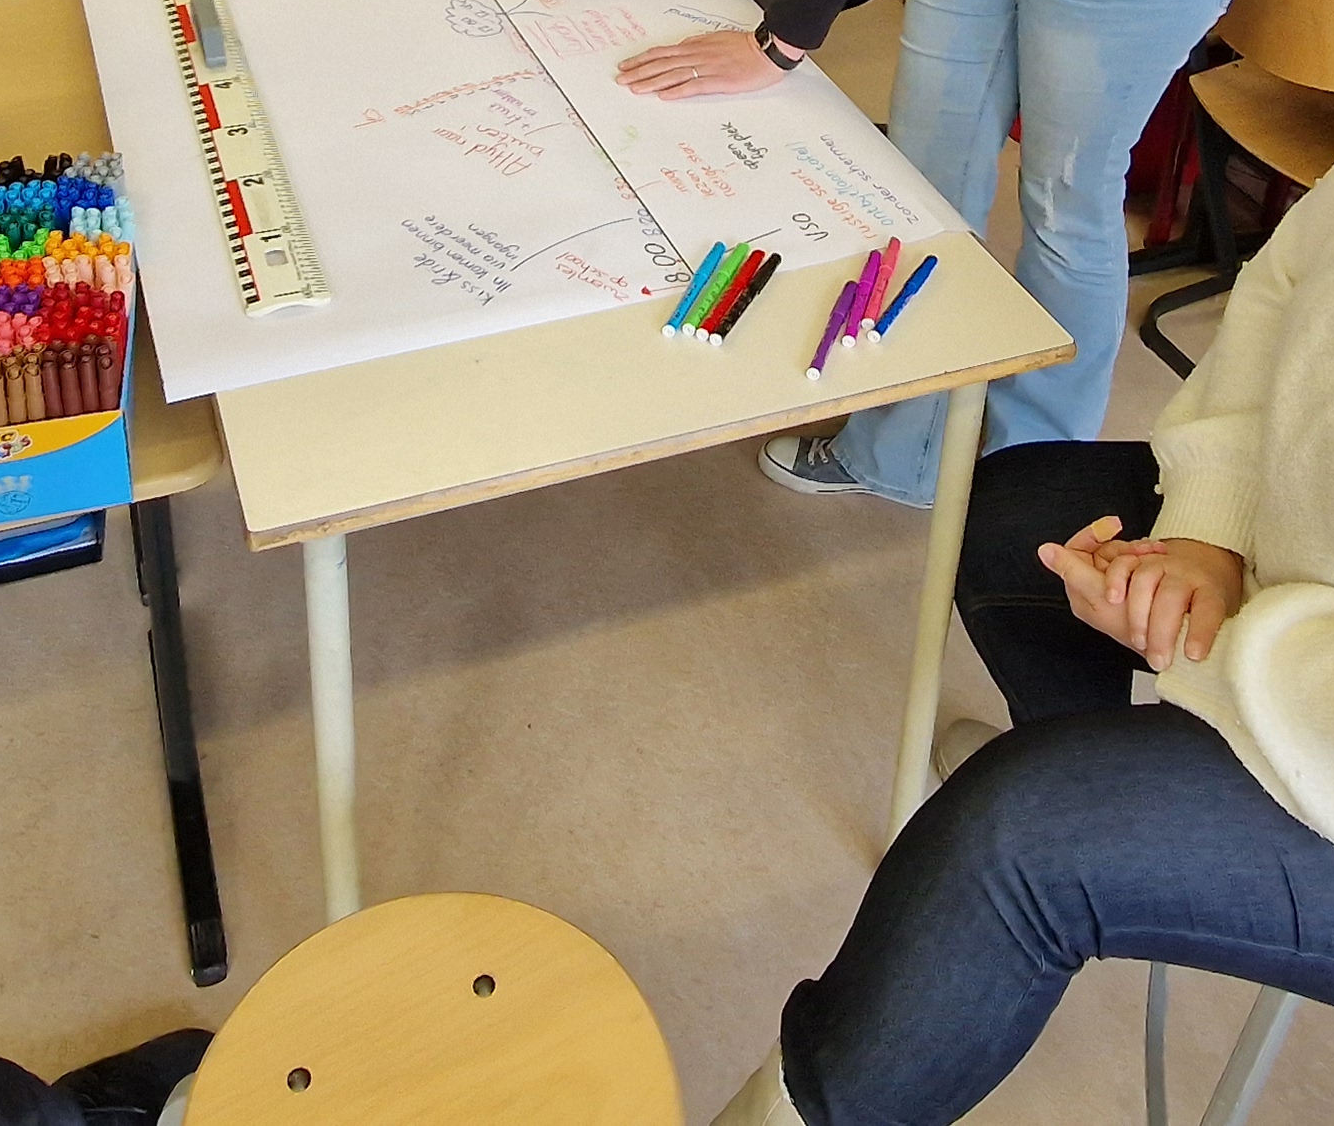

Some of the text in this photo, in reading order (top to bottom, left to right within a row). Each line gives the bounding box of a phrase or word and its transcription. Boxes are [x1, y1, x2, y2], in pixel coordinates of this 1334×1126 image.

[227, 126, 249, 137] 3
[242, 176, 265, 187] 2
[790, 168, 879, 240] rustige start
[259, 233, 283, 243] 1
[401, 218, 446, 253] binnen
[446, 249, 489, 280] komen
[555, 251, 610, 278] school
